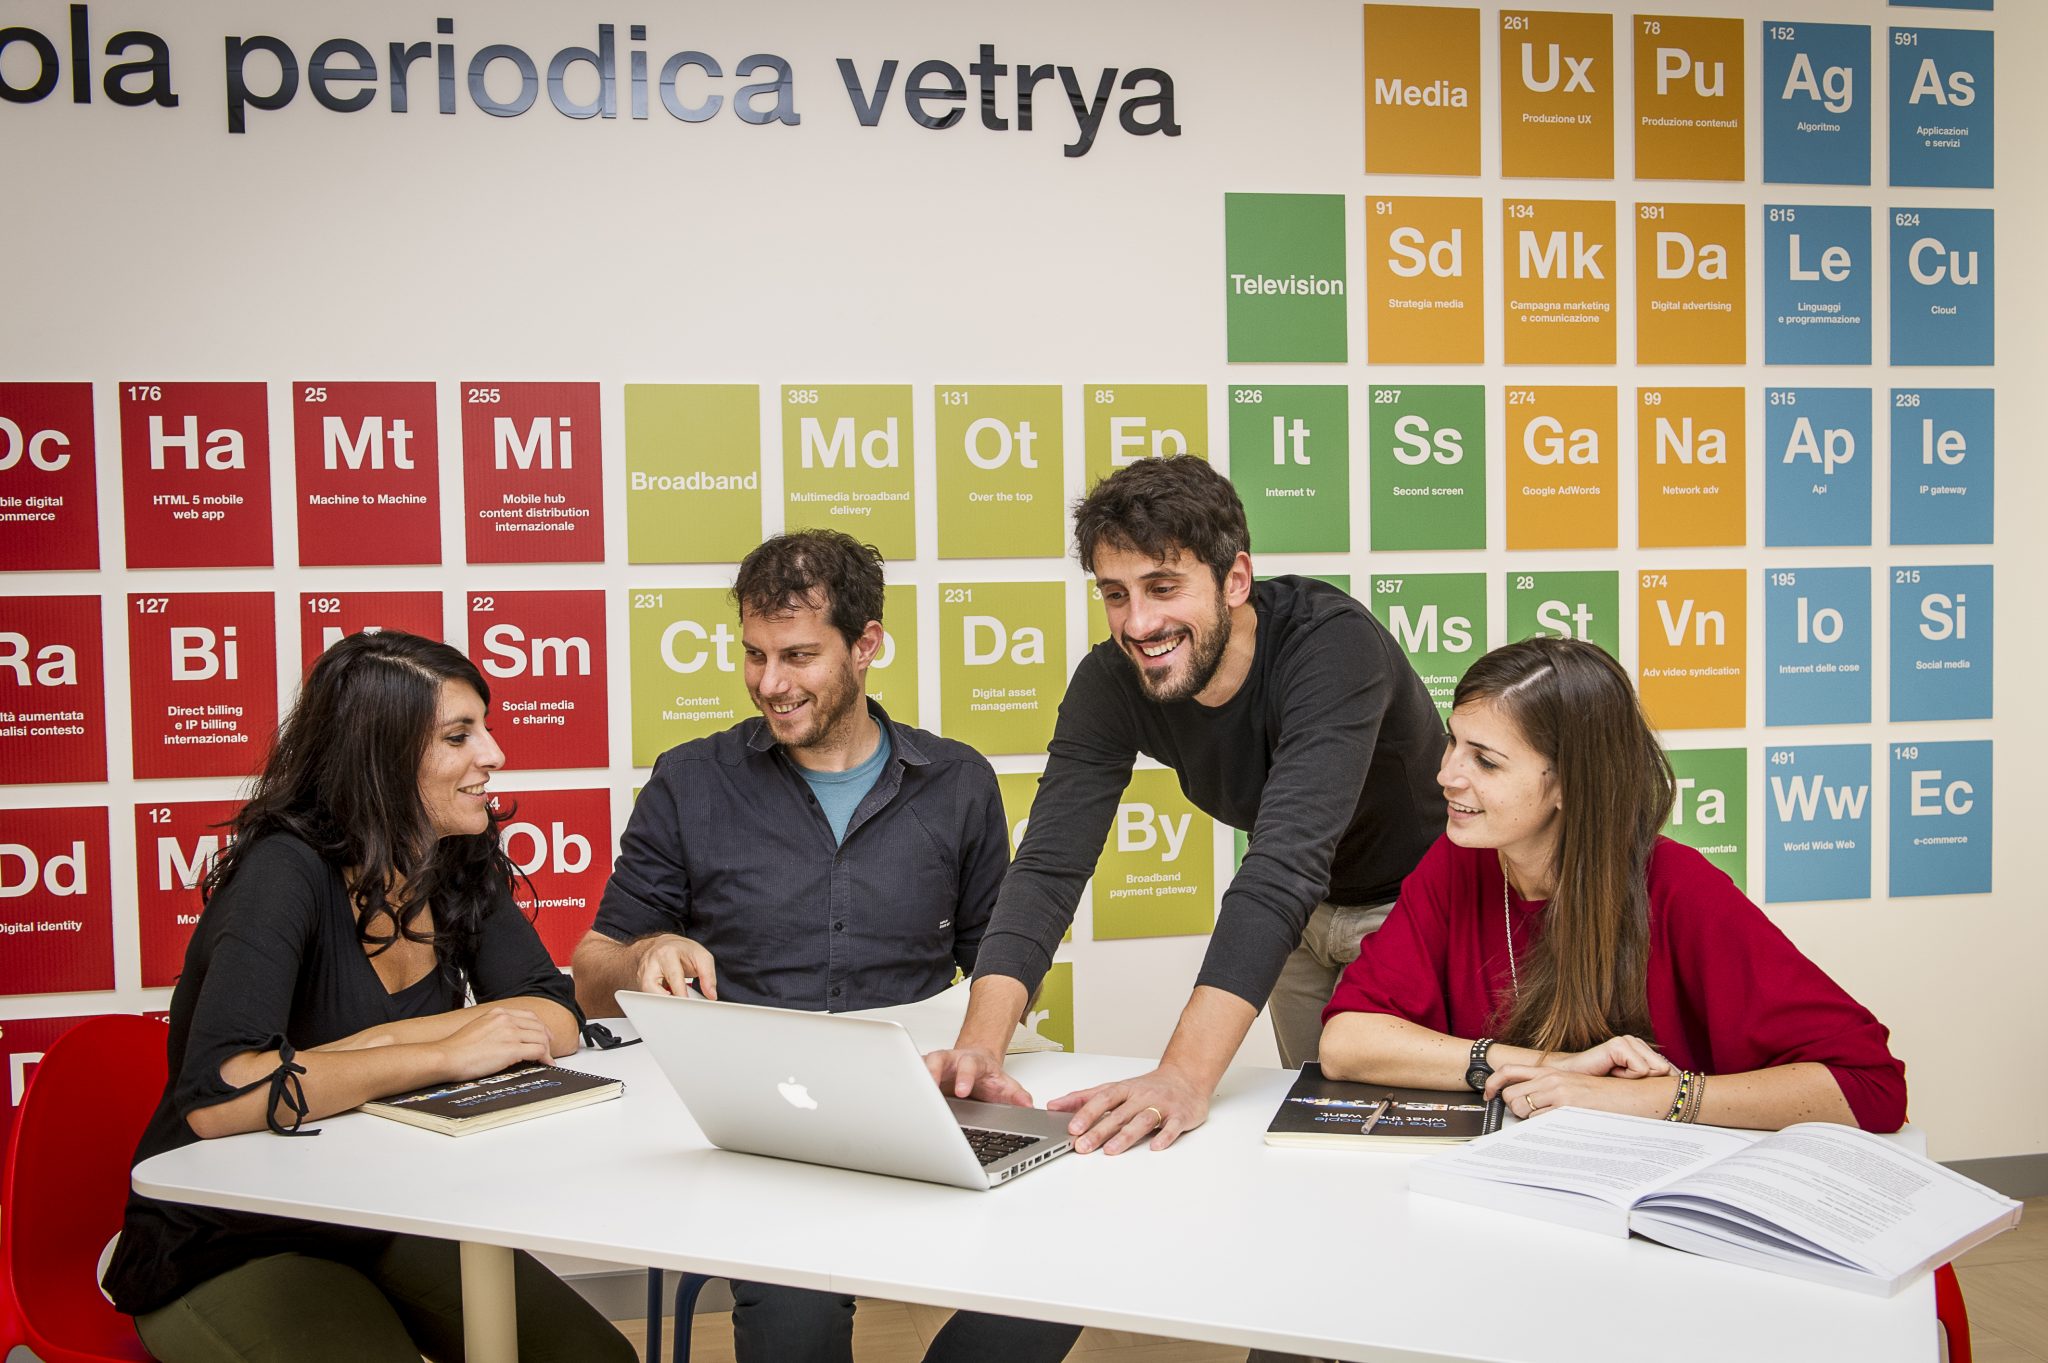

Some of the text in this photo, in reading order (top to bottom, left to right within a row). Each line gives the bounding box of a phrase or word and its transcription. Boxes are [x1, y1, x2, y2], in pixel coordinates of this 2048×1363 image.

[1504, 16, 1529, 29] 261
[1643, 22, 1661, 34] 78
[1770, 27, 1795, 40] 152
[1894, 33, 1918, 45] 591
[1522, 43, 1594, 92] Ux
[1657, 48, 1723, 96] Pu
[224, 18, 800, 133] periodica
[836, 44, 1181, 158] vetrya
[1782, 53, 1852, 113] Ag
[1909, 59, 1975, 106] As
[1376, 78, 1467, 107] Media
[1522, 113, 1592, 124] Produzione UX
[1641, 117, 1738, 128] Produzione contenuti
[1796, 122, 1841, 132] Algoritmo
[1916, 126, 1969, 136] Applicazioni
[1375, 202, 1393, 214] 91
[1508, 205, 1535, 217] 134
[1640, 206, 1665, 219] 391
[1769, 209, 1796, 221] 815
[1895, 214, 1921, 226] 624
[1389, 227, 1462, 277] Sd
[1520, 231, 1604, 279] Mk
[1657, 232, 1727, 280] Da
[1790, 234, 1851, 281] Le
[1909, 238, 1977, 285] Cu
[1231, 274, 1343, 295] Television
[1388, 299, 1464, 309] Strategia media
[1510, 301, 1610, 311] Campagna marketing
[1651, 301, 1732, 312] Digital advertising
[1797, 303, 1841, 313] Linguaggi
[1930, 305, 1957, 315] Cloud
[129, 386, 161, 400] 176
[305, 388, 327, 402] 25
[469, 389, 500, 403] 255
[788, 390, 819, 403] 385
[941, 392, 969, 405] 131
[1095, 390, 1115, 403] 85
[1234, 390, 1263, 403] 326
[1374, 390, 1402, 403] 287
[1508, 391, 1537, 404] 274
[1644, 392, 1662, 405] 99
[1770, 392, 1796, 405] 315
[1895, 394, 1921, 406] 236
[149, 416, 245, 470] Ha
[323, 417, 414, 469] Mt
[494, 417, 572, 469] Mi
[801, 417, 898, 468] Md
[965, 418, 1037, 469] Ot
[1274, 416, 1310, 465] It
[1393, 416, 1463, 465] Ss
[1524, 416, 1598, 465] Ga
[1656, 418, 1726, 464] Na
[1783, 417, 1854, 474] Ap
[1923, 419, 1966, 464] Ie
[632, 472, 757, 490] Broadband
[790, 491, 910, 501] Multimedia broadband
[1265, 487, 1316, 497] Internet tv
[1393, 486, 1464, 496] Second screen
[1522, 485, 1601, 496] Google AdWords
[1662, 485, 1719, 495] Network adv
[1812, 485, 1827, 494] Api
[1919, 484, 1967, 495] IP gateway
[25, 497, 63, 508] digital
[153, 495, 244, 504] HTML 5 mobile
[309, 494, 427, 504] Machine to Machine
[503, 494, 566, 503] Mobile hub
[968, 492, 1033, 502] Over the top
[173, 509, 225, 520] web app
[479, 508, 590, 518] content distribution
[830, 506, 872, 516] delivery
[495, 522, 575, 531] internazionale
[1516, 576, 1535, 589] 28
[1642, 575, 1668, 588] 374
[1771, 573, 1796, 586] 195
[1895, 570, 1921, 583] 215
[1376, 580, 1403, 593] 357
[635, 594, 662, 608] 231
[944, 589, 972, 602] 231
[137, 599, 168, 613] 127
[309, 598, 340, 613] 192
[473, 597, 494, 611] 22
[1657, 600, 1724, 646] Vn
[1798, 598, 1843, 643] Io
[1920, 594, 1965, 640] Si
[1390, 605, 1472, 653] Ms
[661, 621, 735, 673] Ct
[964, 616, 1044, 665] Da
[171, 627, 237, 680] Bi
[483, 624, 590, 678] Sm
[0, 632, 77, 686] Ra
[1915, 659, 1971, 670] Social media
[1643, 667, 1740, 677] Adv video syndication
[1779, 663, 1860, 674] Internet delle cose
[972, 687, 1036, 699] Digital asset
[502, 700, 575, 711] Social media
[675, 697, 720, 706] Content
[970, 701, 1039, 712] management
[18, 711, 84, 721] aumentata
[167, 705, 243, 716] Direct billing
[662, 710, 734, 721] Management
[30, 725, 85, 735] contesto
[164, 733, 249, 744] internazionale
[1771, 752, 1795, 764] 491
[1894, 747, 1919, 759] 149
[1771, 775, 1868, 822] Ww
[1911, 770, 1973, 816] Ec
[150, 808, 171, 823] 12
[1116, 803, 1192, 861] By
[1783, 839, 1856, 851] World Wide Web
[1913, 836, 1968, 846] e-commerce
[0, 841, 86, 897] Dd
[1126, 872, 1181, 883] Broadband
[1109, 886, 1198, 898] payment gateway
[37, 921, 83, 931] identity
